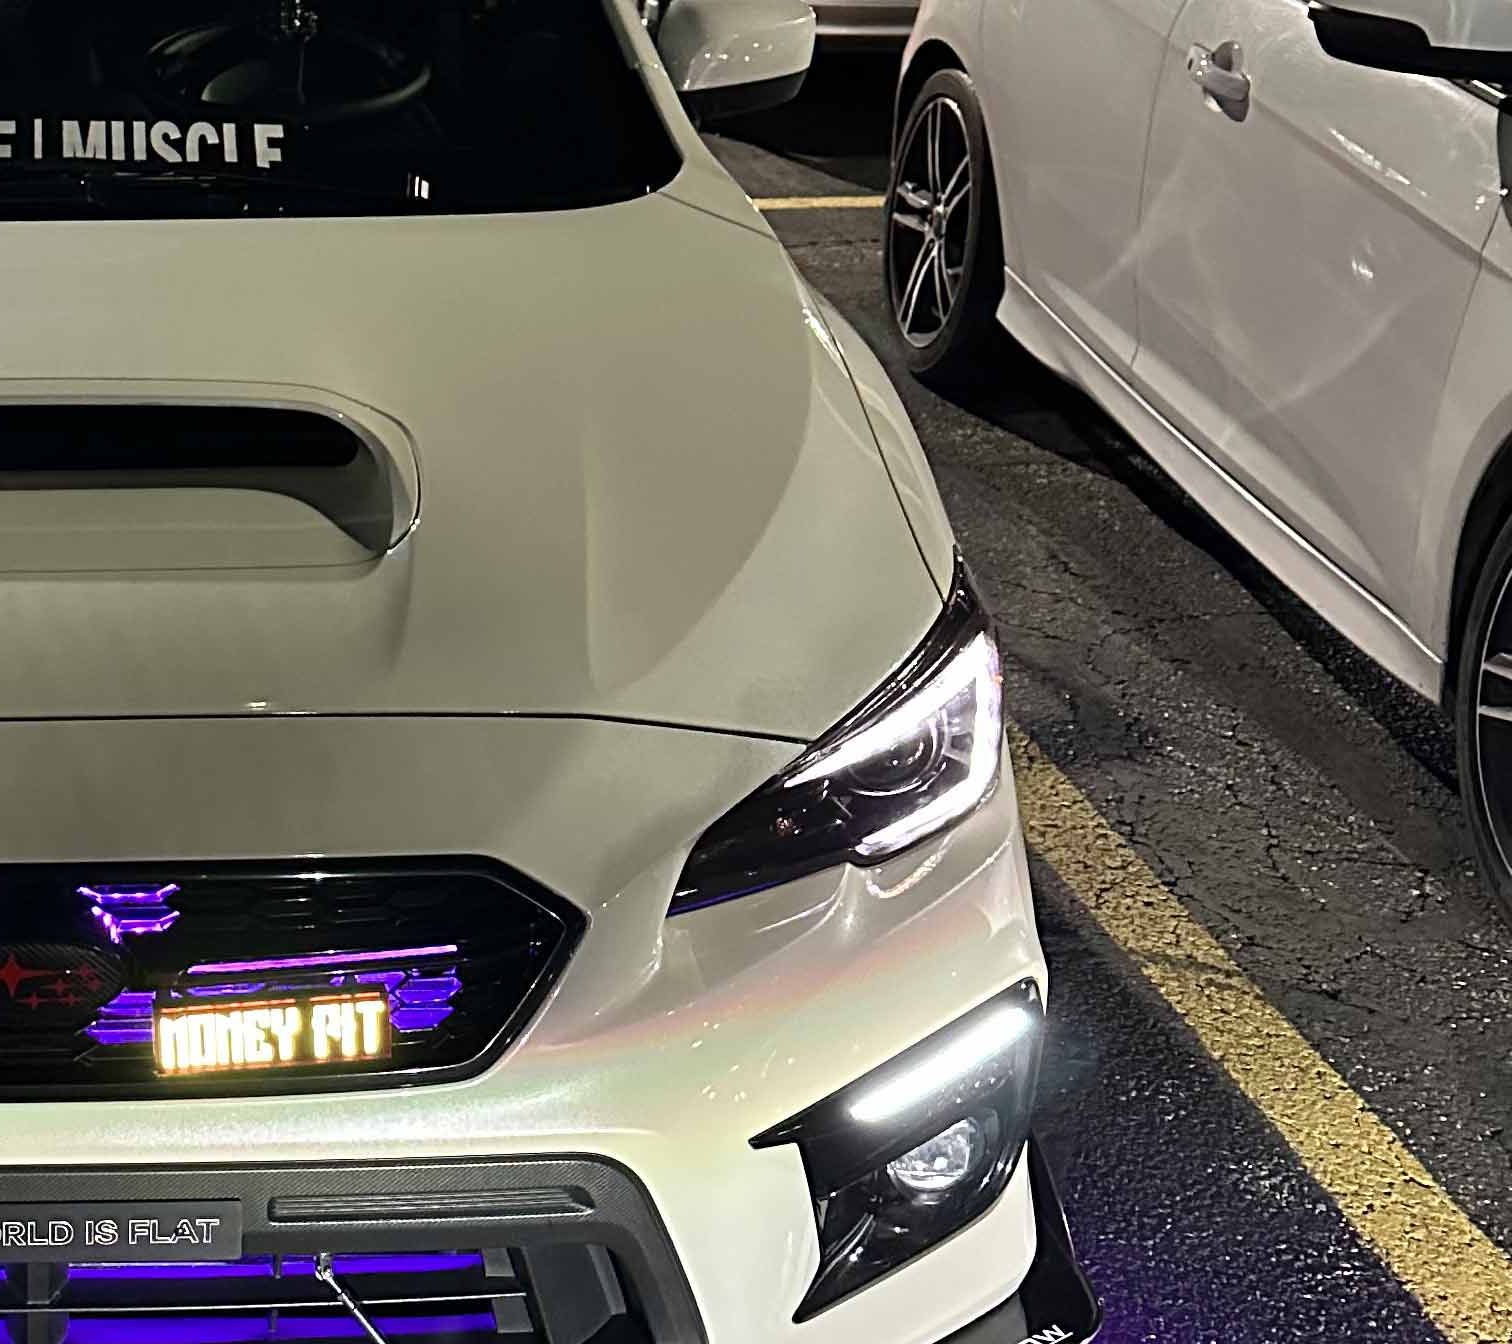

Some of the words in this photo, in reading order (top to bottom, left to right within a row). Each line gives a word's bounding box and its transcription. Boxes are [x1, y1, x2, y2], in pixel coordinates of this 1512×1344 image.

[159, 1006, 300, 1070] MONEY
[312, 1000, 385, 1059] PIT
[85, 1219, 119, 1246] IS
[128, 1218, 220, 1245] FLAT
